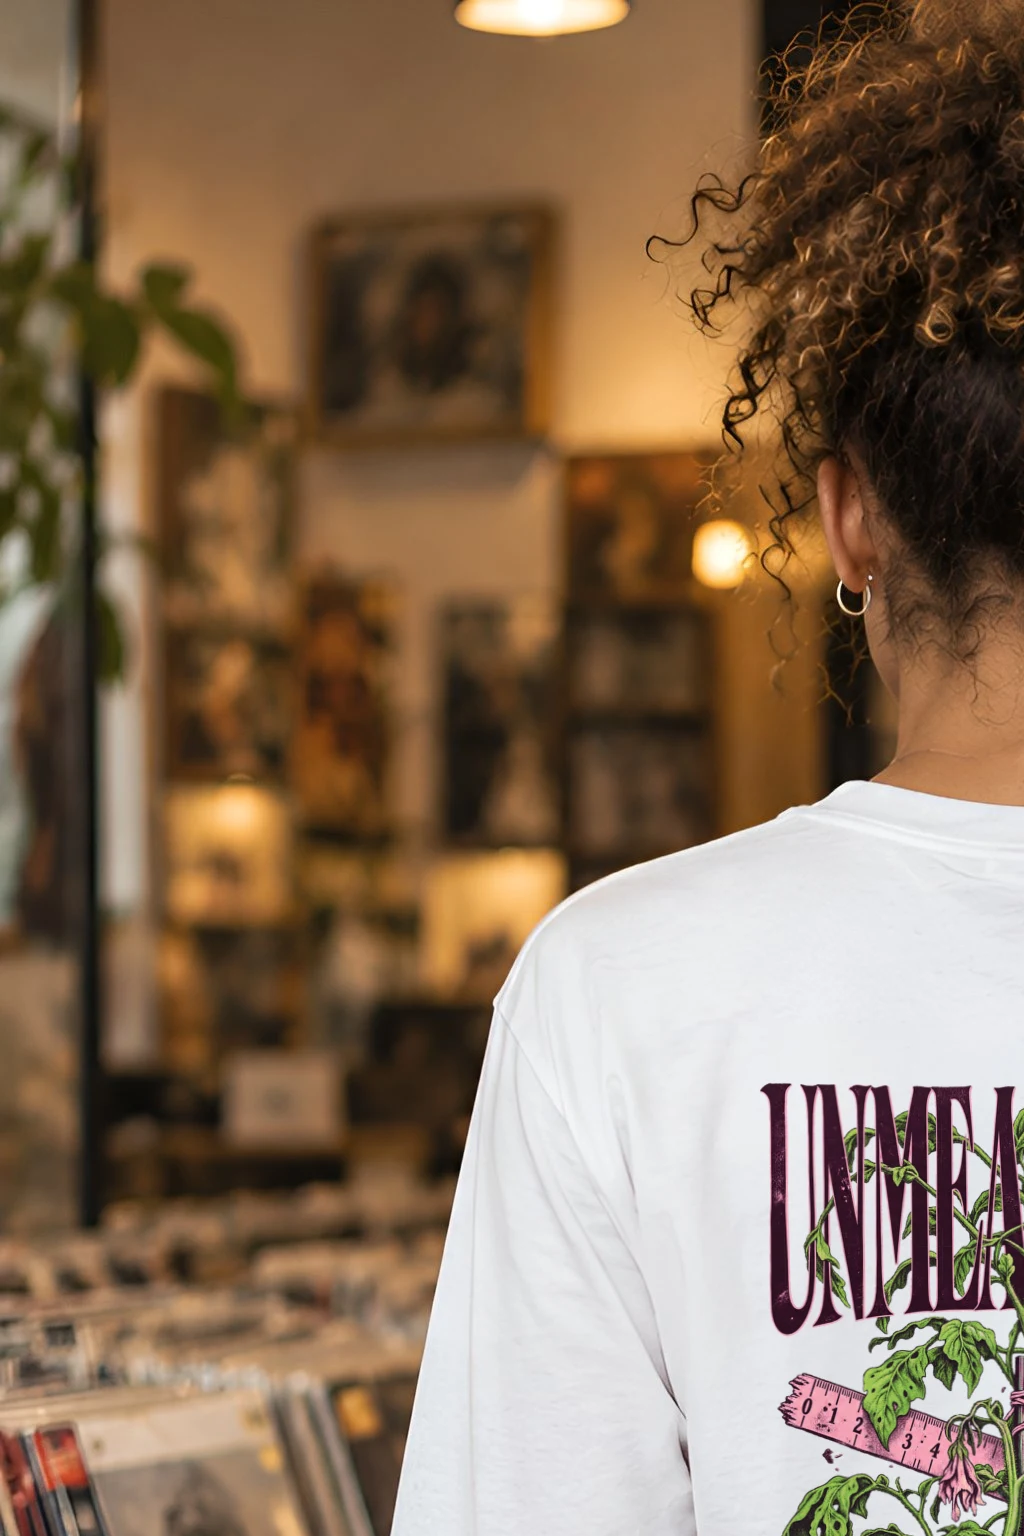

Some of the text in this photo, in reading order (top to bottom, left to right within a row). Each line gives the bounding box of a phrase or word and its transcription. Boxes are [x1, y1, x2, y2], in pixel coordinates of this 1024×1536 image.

[801, 1397, 941, 1459] 0 1 2 3 4
